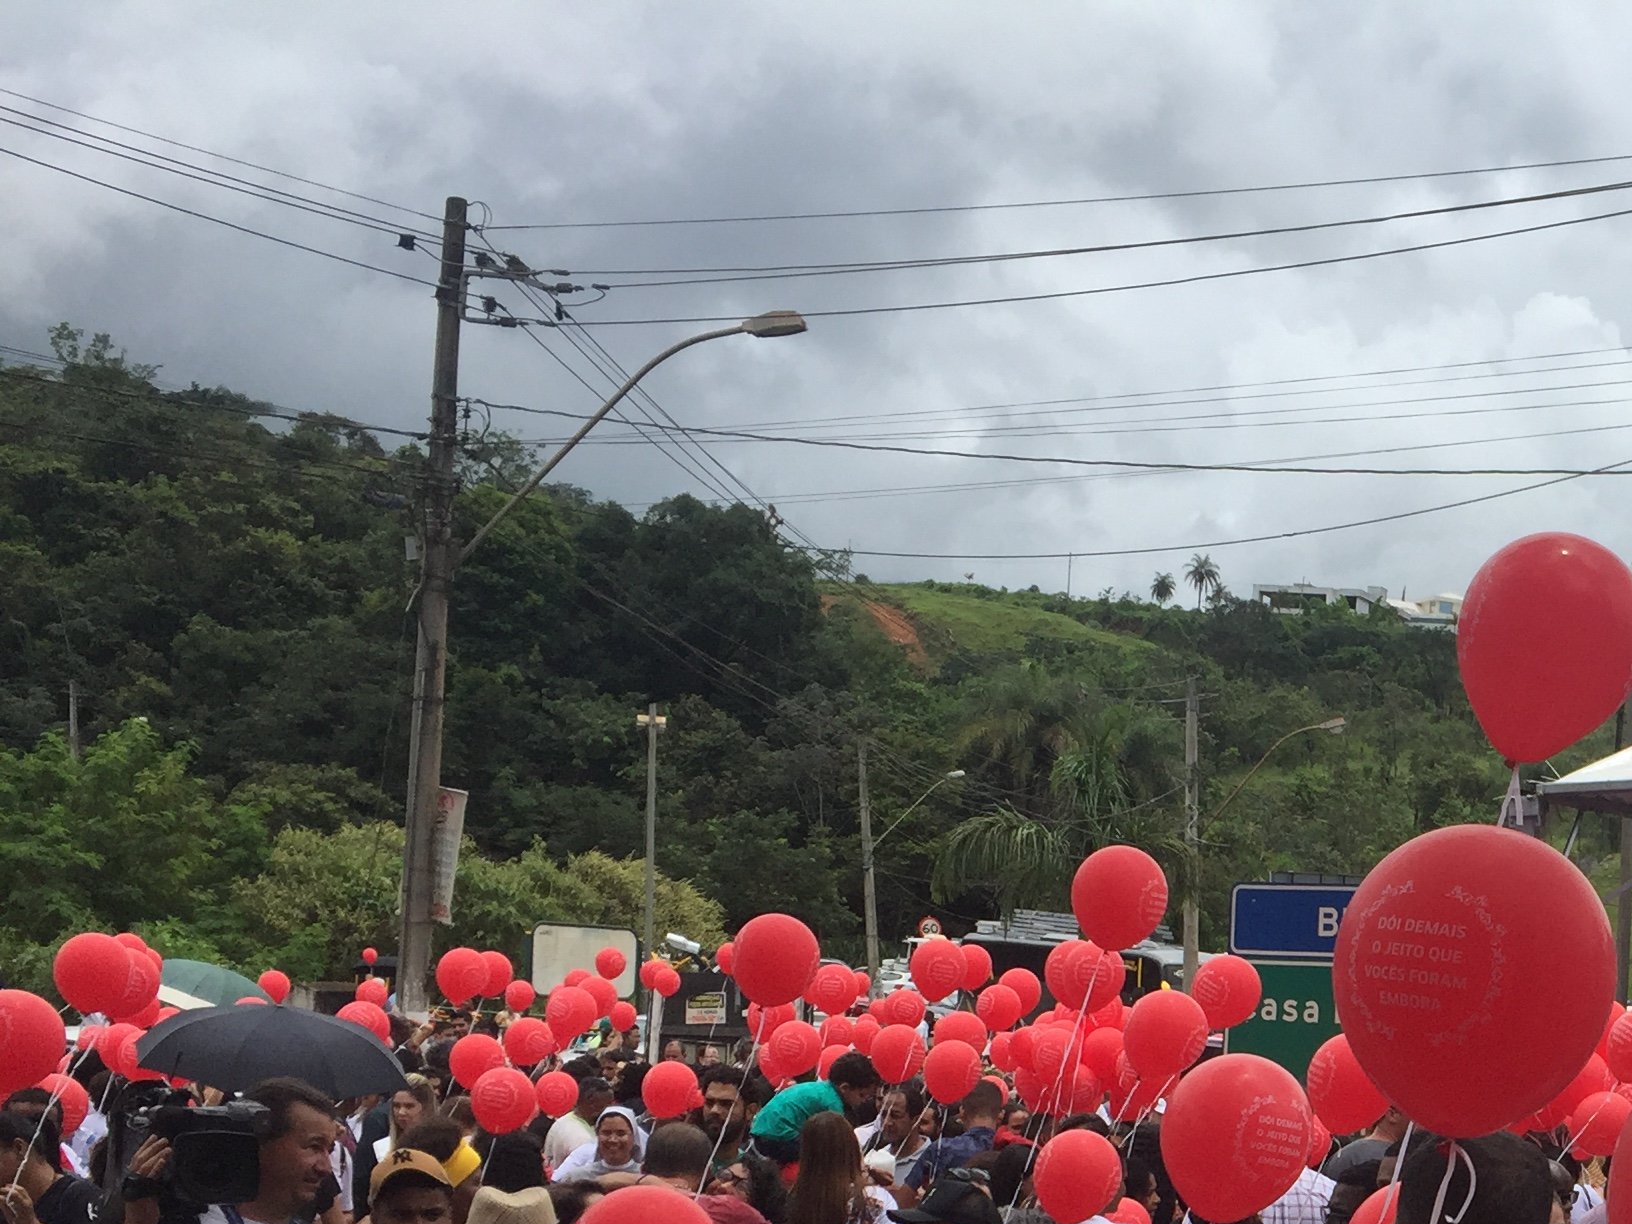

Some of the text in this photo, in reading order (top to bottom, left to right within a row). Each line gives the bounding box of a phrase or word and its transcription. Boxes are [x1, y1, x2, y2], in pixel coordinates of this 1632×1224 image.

[922, 923, 939, 934] 60
[1317, 906, 1345, 938] B
[1378, 915, 1467, 938] DÓI DEMAIS
[1372, 940, 1463, 964] O JEITO QUE
[1365, 964, 1467, 990] VOCÊS FORAM
[1248, 998, 1320, 1024] asa
[1379, 990, 1440, 1010] EMBORA
